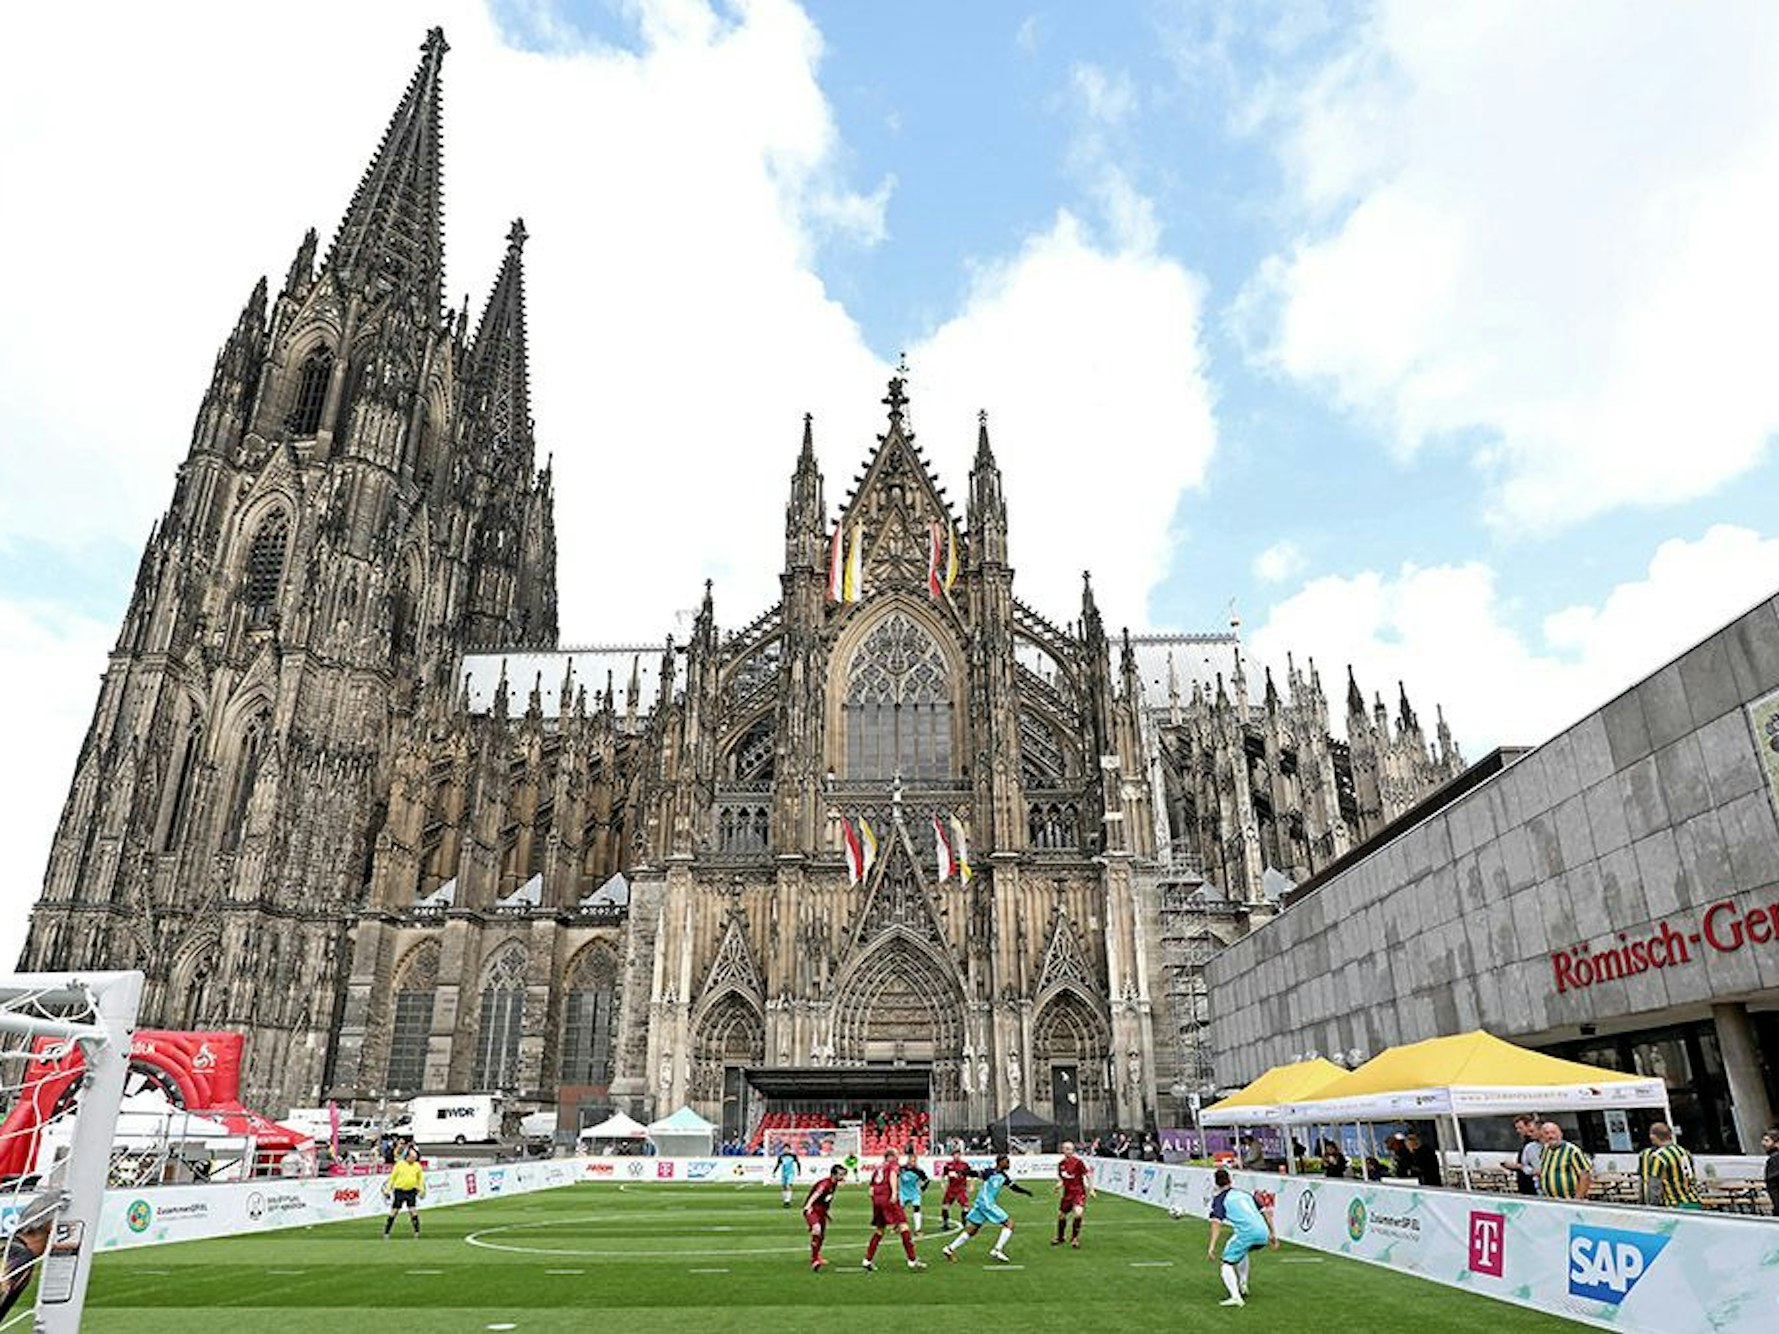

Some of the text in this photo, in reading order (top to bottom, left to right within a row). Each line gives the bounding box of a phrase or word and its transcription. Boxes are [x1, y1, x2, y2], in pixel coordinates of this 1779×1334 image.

[446, 1107, 476, 1118] WDR
[1475, 1219, 1498, 1267] T
[1570, 1236, 1644, 1293] SAP
